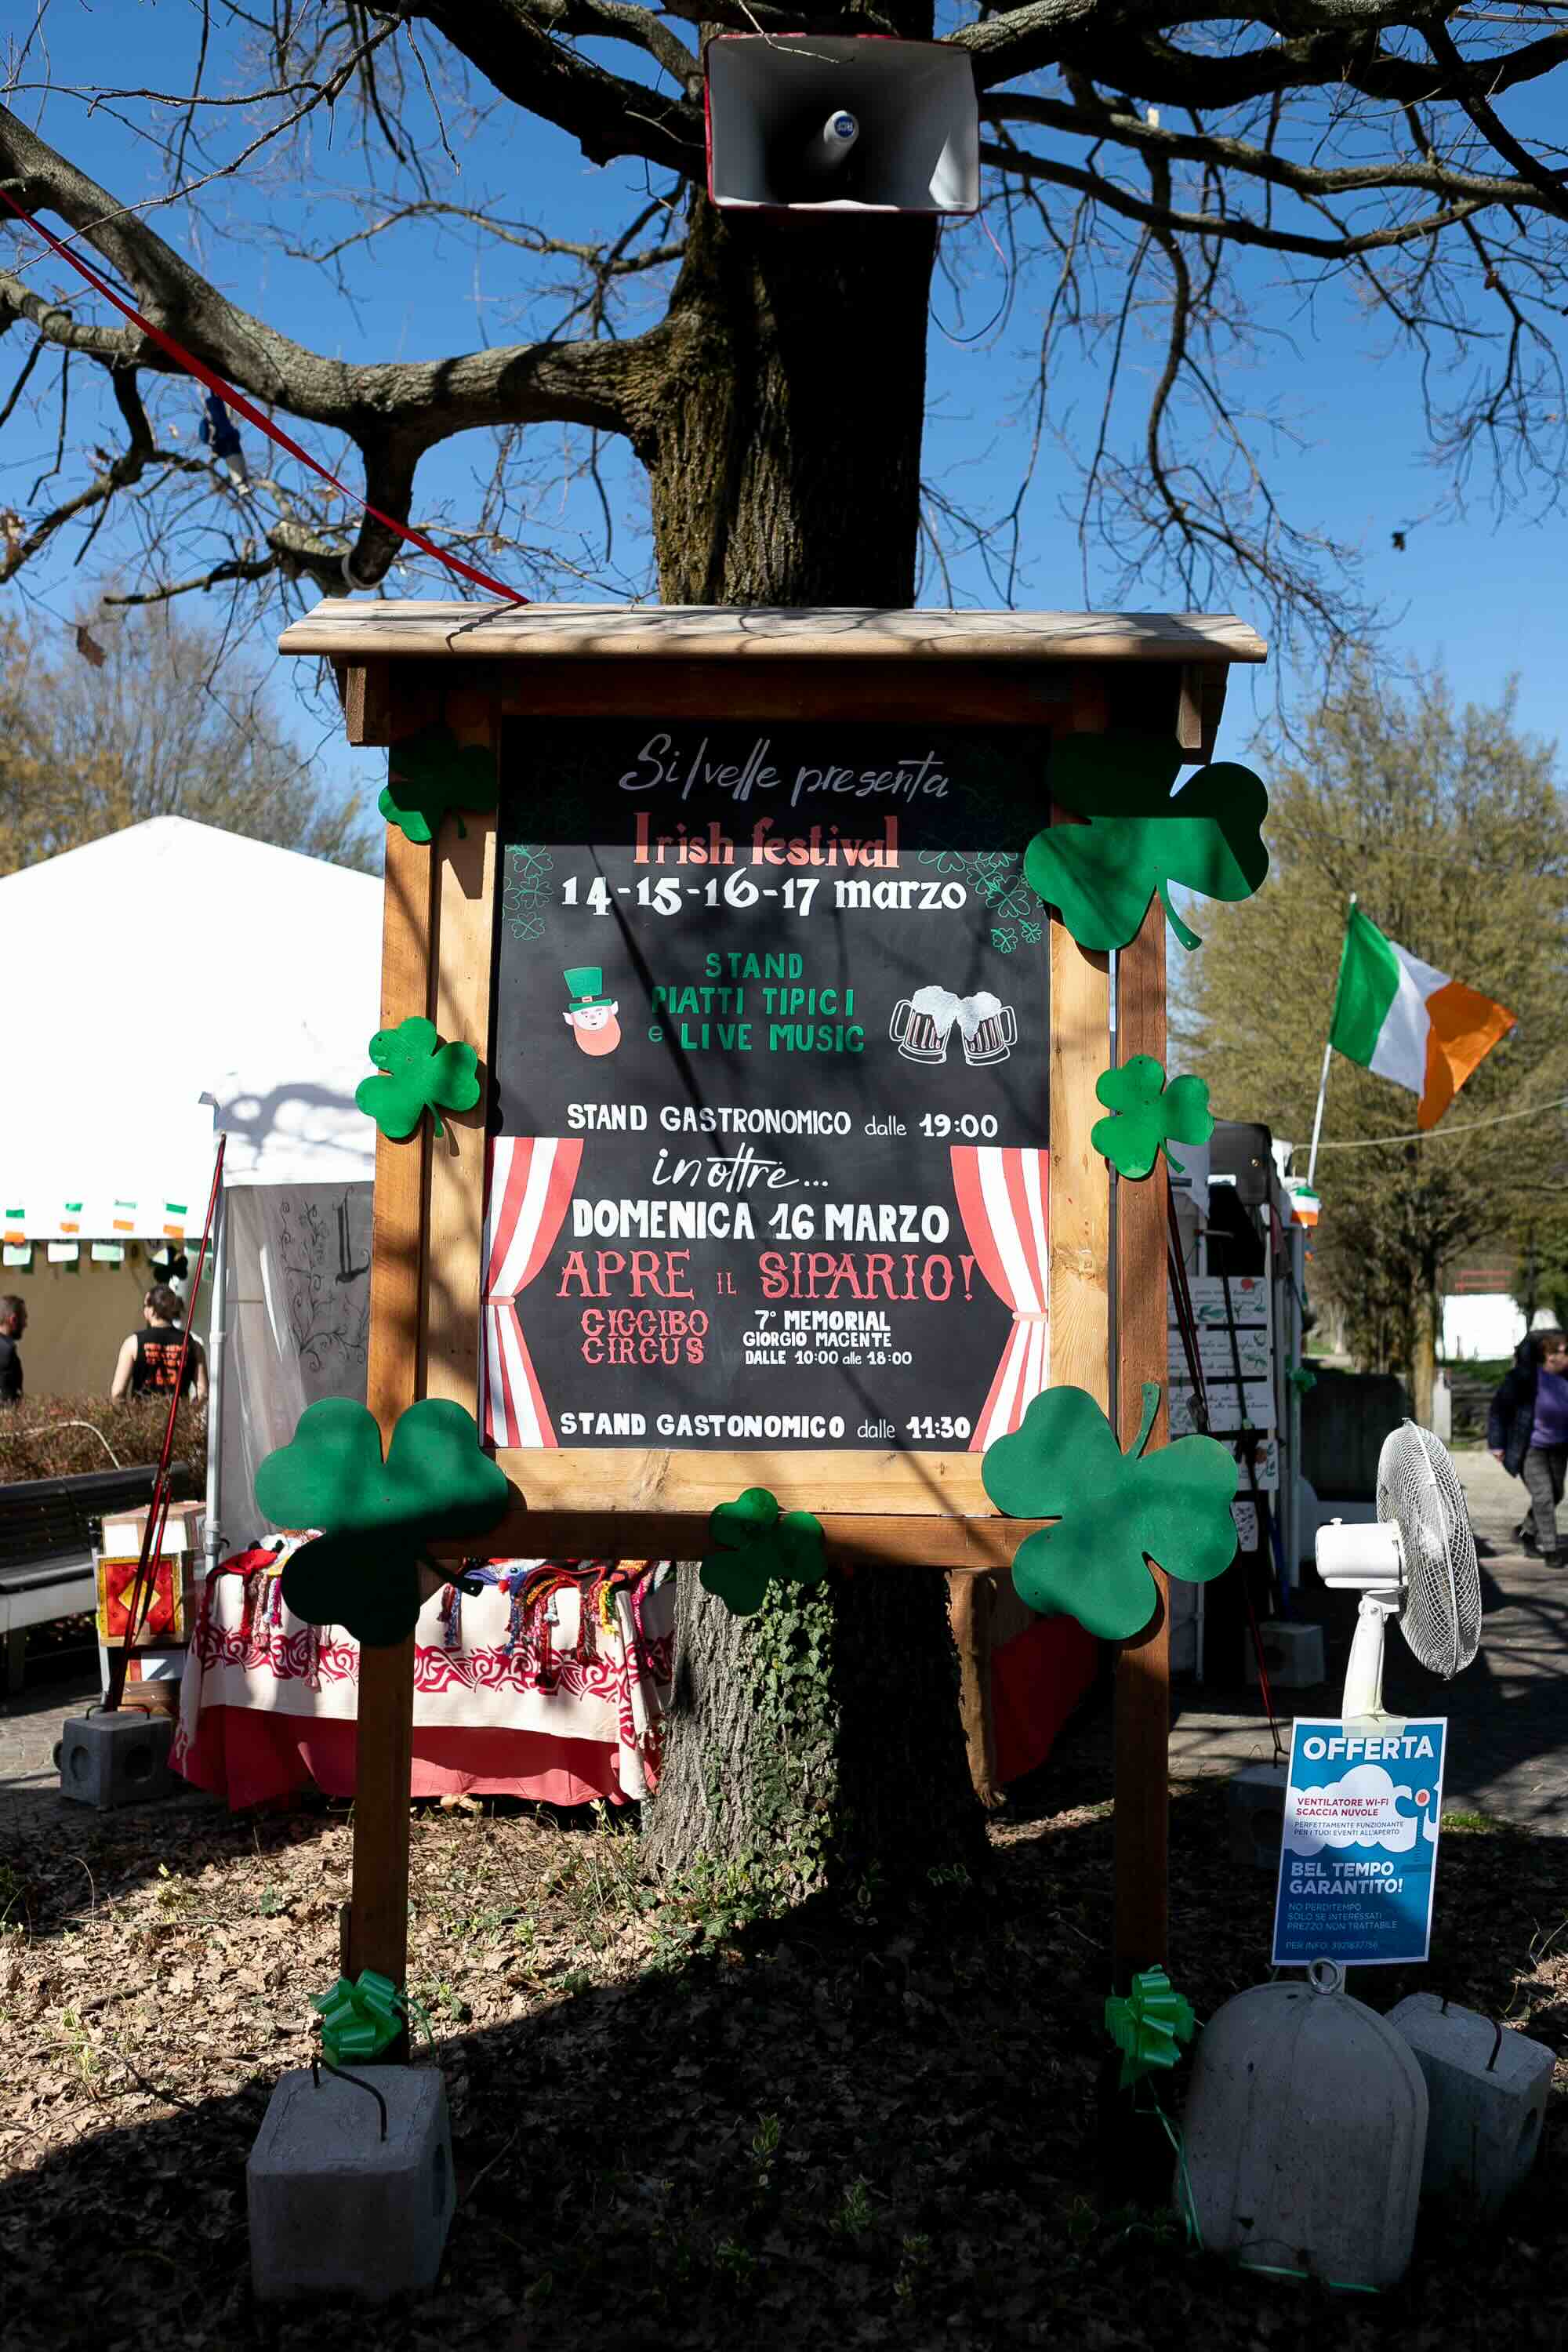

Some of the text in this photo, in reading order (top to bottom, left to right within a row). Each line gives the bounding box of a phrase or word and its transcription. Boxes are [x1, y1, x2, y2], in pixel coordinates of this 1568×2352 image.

[619, 733, 949, 808] Silvelle presenta
[633, 811, 900, 868] Irish festival
[833, 879, 967, 910] marzo
[706, 953, 804, 979] STAND
[652, 985, 854, 1017] PIATTI TIPICI
[648, 1022, 864, 1052] e LIVE MUSIC
[567, 1104, 998, 1138] STAND GASTRONOMICO dalle 19:00
[572, 1199, 949, 1243] DOMENICA 16 MARZO
[556, 1248, 975, 1301] APRE IL SIPARIO!
[581, 1308, 709, 1337] CICCIBO
[754, 1310, 891, 1331] 7° MEMORIAL
[581, 1337, 705, 1365] CIRCUS
[742, 1331, 892, 1348] GIORGIO MACENTE
[745, 1350, 913, 1365] DALLE 10:00 alle 18:00
[560, 1412, 971, 1439] STAND GASTONOMICO dalle 11:30
[1303, 1735, 1434, 1761] OFFERTA
[1296, 1808, 1379, 1817] SCACCIA NUVOLE
[1298, 1798, 1388, 1806] VENTILATORE WI-FI
[1291, 1861, 1394, 1877] BEL TEMPO
[1290, 1878, 1404, 1895] GARANTITO!
[1288, 1903, 1302, 1911] NO
